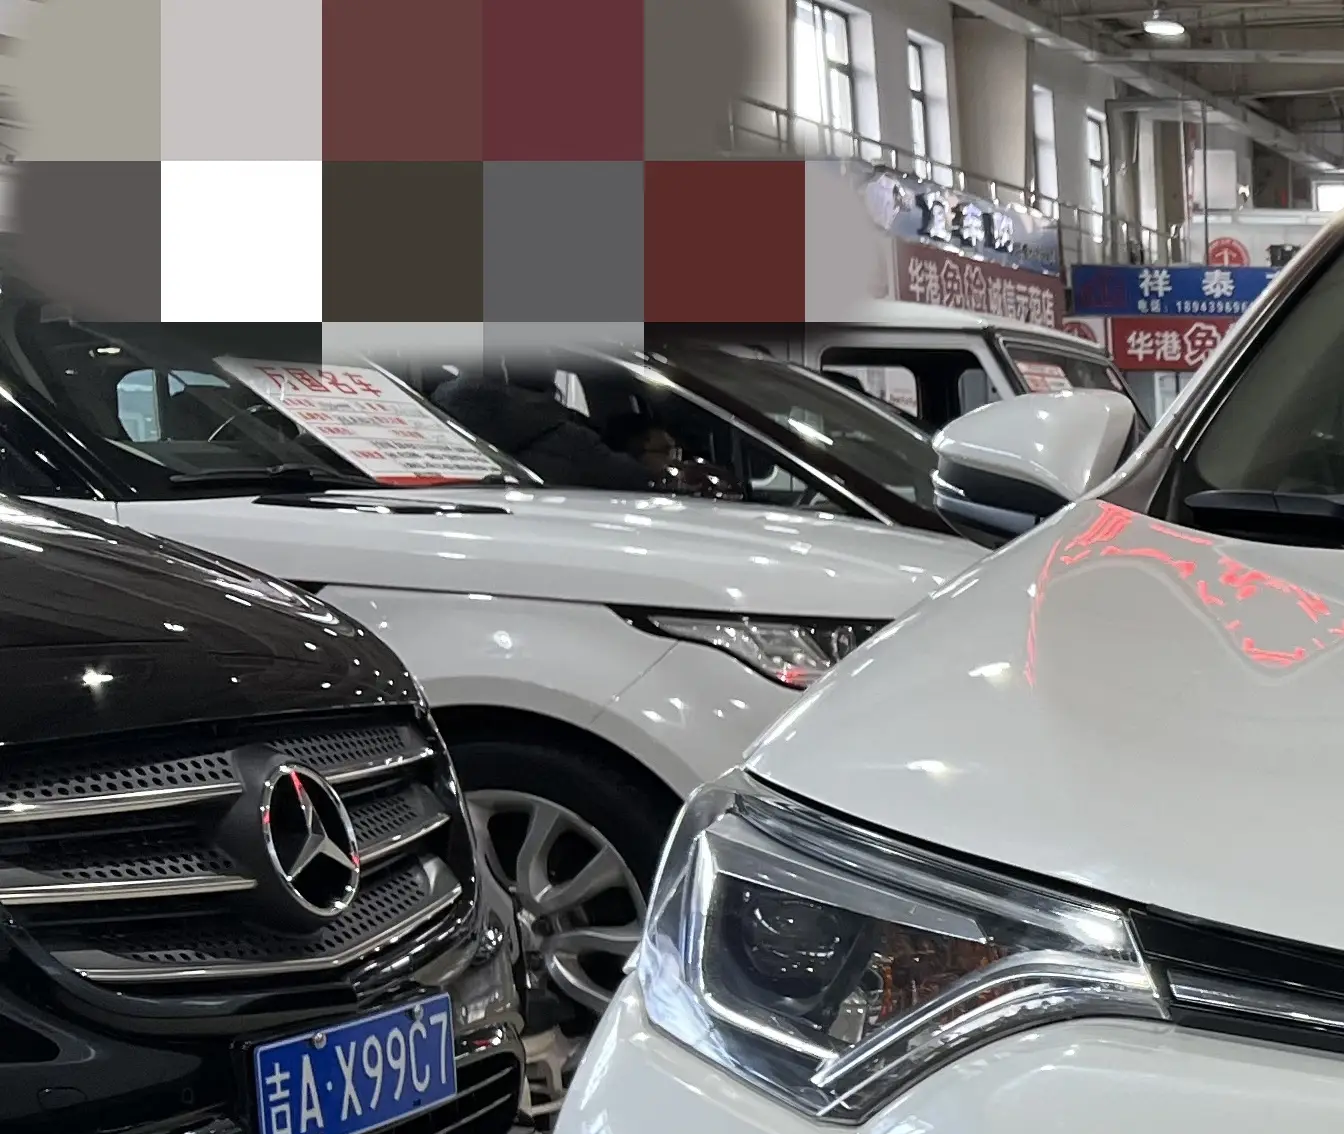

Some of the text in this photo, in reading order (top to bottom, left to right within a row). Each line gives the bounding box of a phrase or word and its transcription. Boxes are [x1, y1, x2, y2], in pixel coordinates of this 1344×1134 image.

[1138, 268, 1281, 298] 祥泰
[1127, 321, 1236, 366] 华港免
